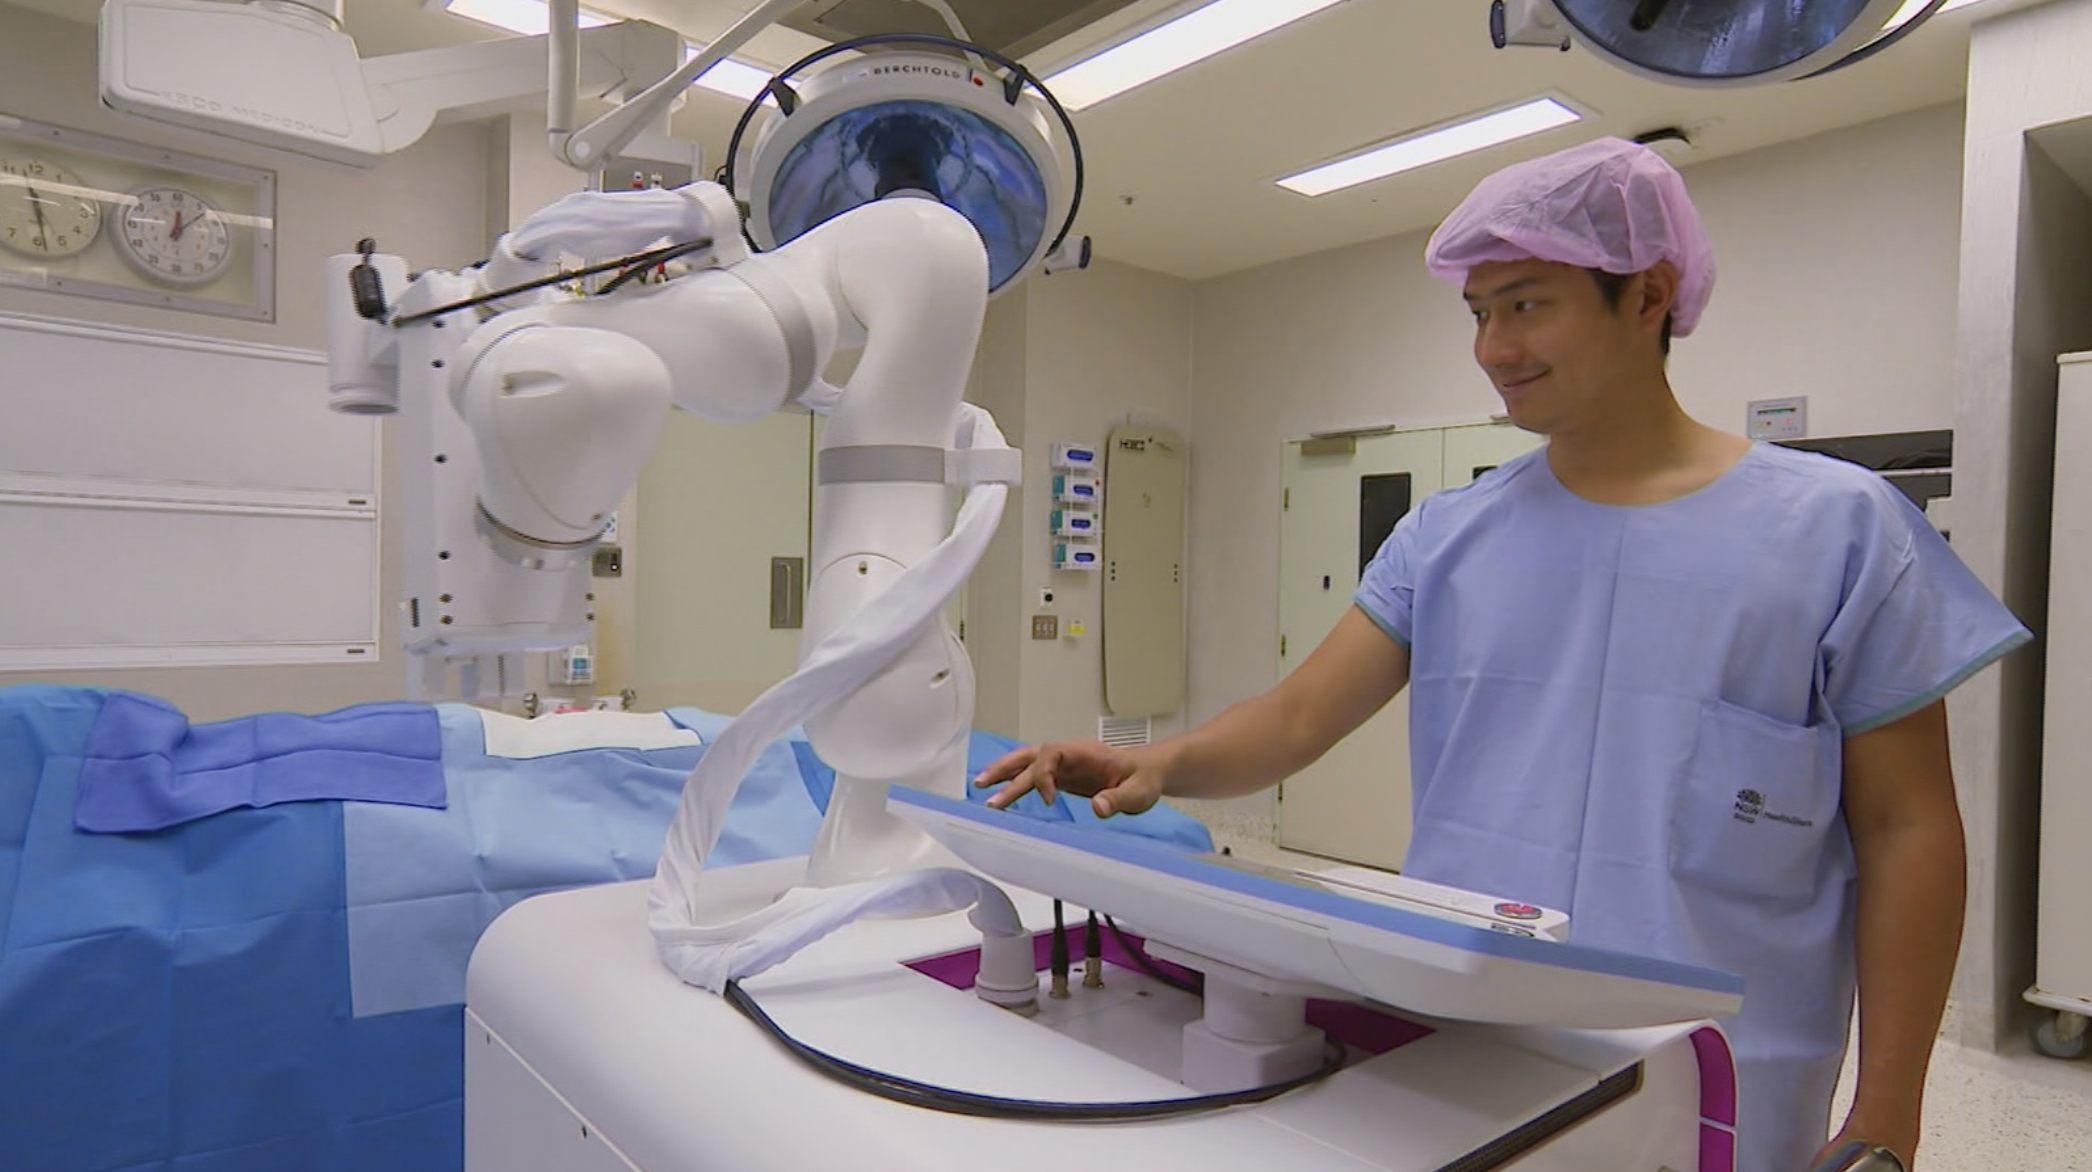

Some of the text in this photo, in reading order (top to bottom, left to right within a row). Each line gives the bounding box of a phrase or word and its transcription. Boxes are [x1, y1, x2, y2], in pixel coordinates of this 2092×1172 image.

[873, 64, 961, 79] BERCHTOLD
[28, 163, 44, 176] 12
[7, 226, 17, 238] 7
[72, 225, 82, 235] 4
[32, 235, 43, 247] 6
